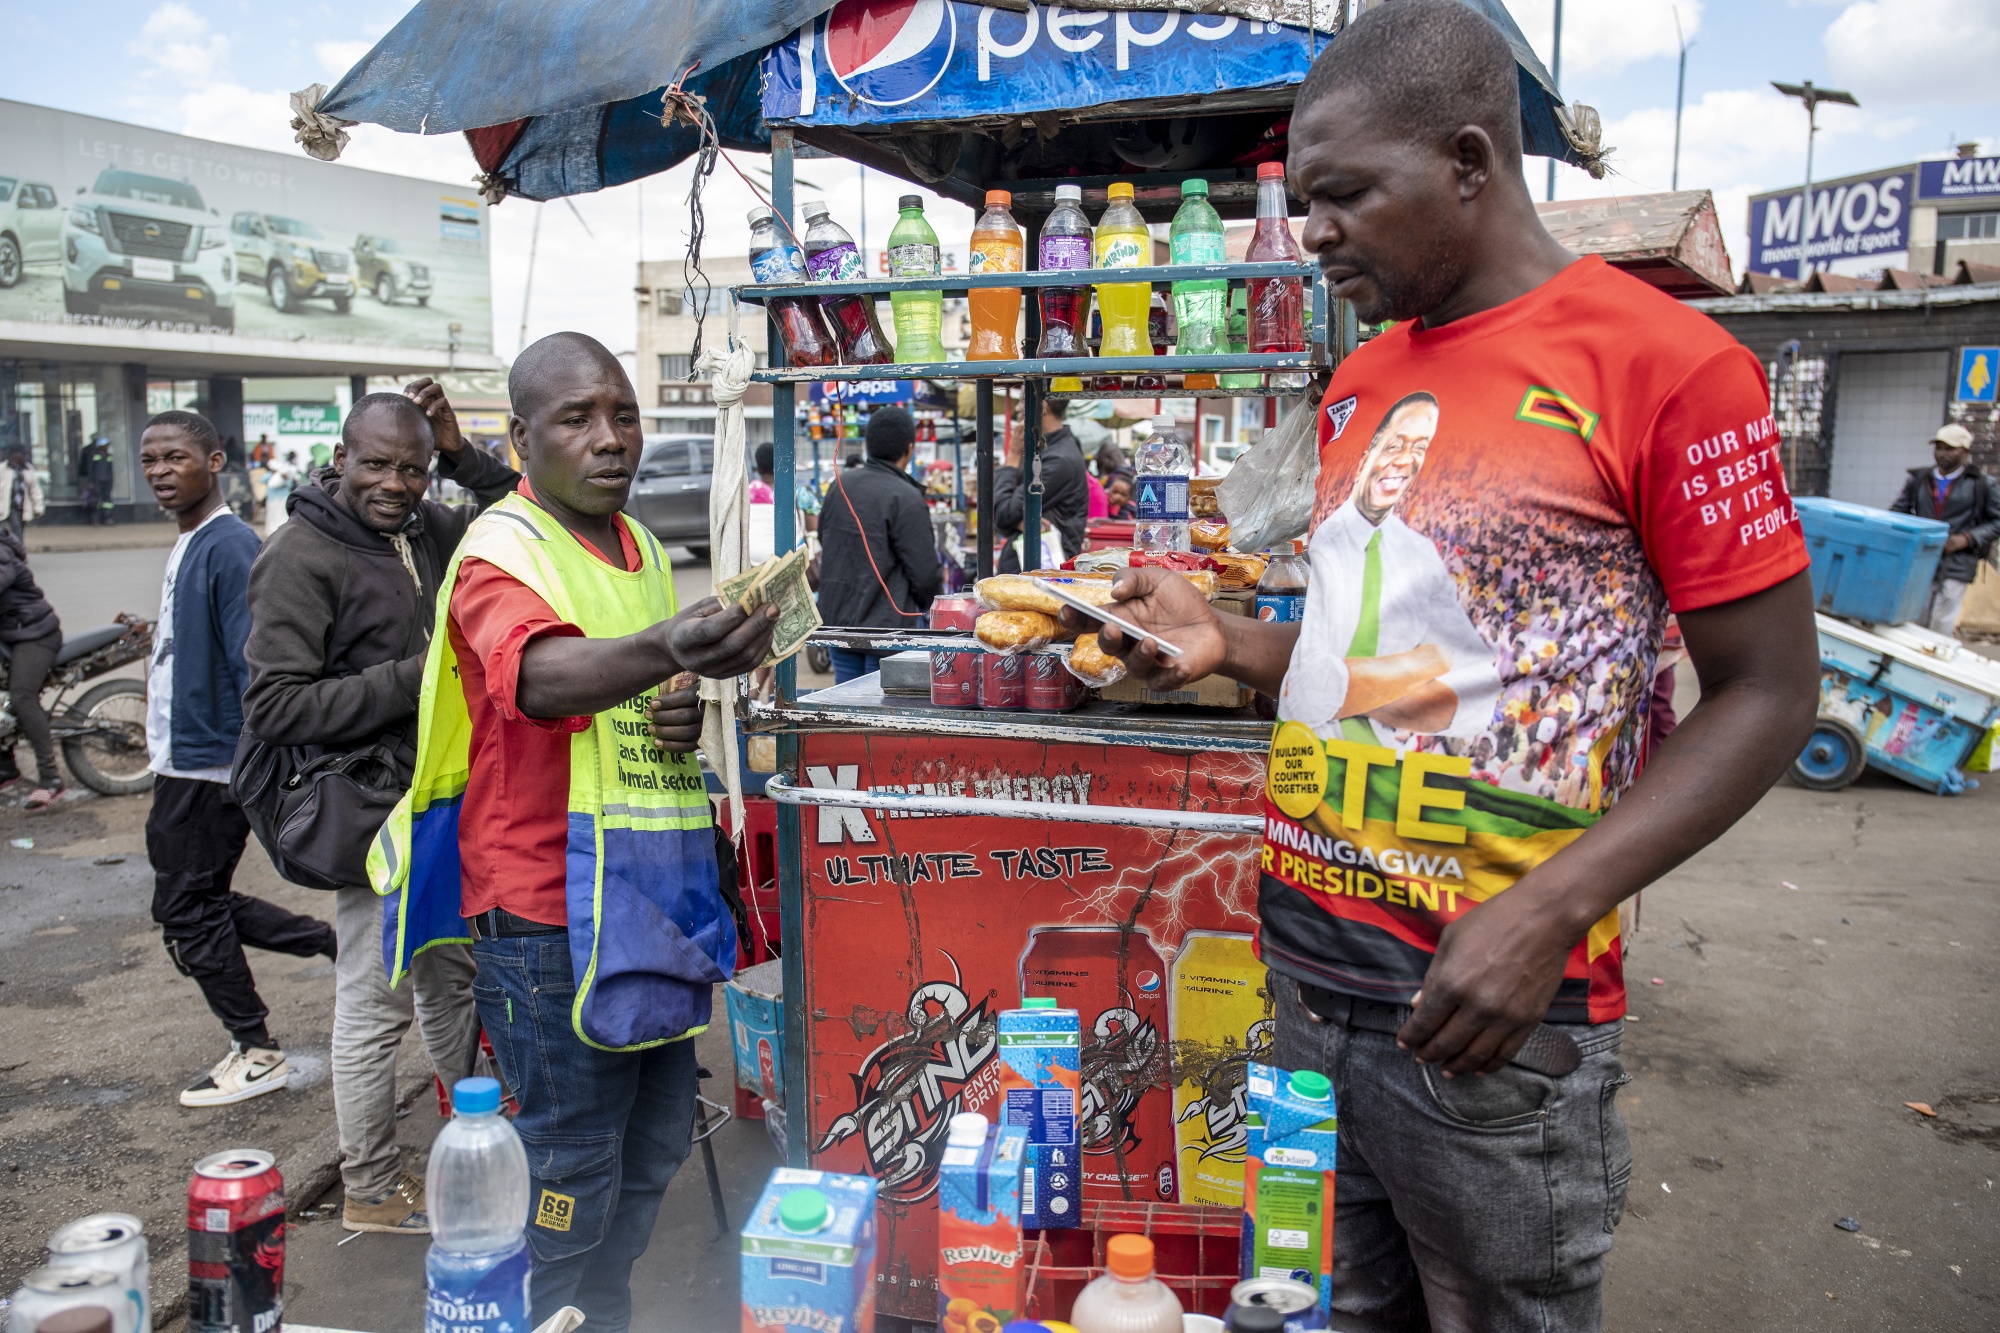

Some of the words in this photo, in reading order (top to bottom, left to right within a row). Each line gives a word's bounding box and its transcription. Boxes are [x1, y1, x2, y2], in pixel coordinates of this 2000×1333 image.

[79, 137, 145, 166] LET'S
[152, 152, 196, 174] GET
[202, 160, 228, 182] TO
[235, 168, 295, 191] WORK
[1761, 176, 1905, 247] MWOS
[1805, 233, 1842, 259] world
[1844, 231, 1858, 254] of
[1859, 226, 1902, 253] sport
[63, 312, 101, 328] BEST
[847, 380, 898, 397] pepsi
[291, 406, 325, 419] Omnia
[279, 419, 298, 432] Cash
[311, 421, 339, 434] Carry
[1686, 430, 1740, 466] OUR
[1682, 475, 1709, 501] IS
[1717, 449, 1769, 488] BEST
[1700, 497, 1732, 526] BY
[1743, 479, 1774, 512] IT'S
[1740, 502, 1799, 546] PEOPLE
[641, 742, 664, 764] for
[1275, 746, 1314, 758] BUILDING
[1285, 759, 1303, 770] OUR
[1274, 771, 1315, 782] COUNTRY
[1273, 783, 1319, 794] TOGETHER
[1267, 818, 1465, 880] MNANGAGWA
[825, 852, 982, 886] ULTIMATE
[990, 847, 1113, 881] TASTE
[1280, 850, 1465, 913] PRESIDENT
[1189, 975, 1247, 987] VITAMINS
[964, 1058, 1000, 1100] ENER
[1196, 1173, 1225, 1185] GOLD
[542, 1194, 570, 1218] 69
[540, 1212, 568, 1224] ORIGINAL
[540, 1217, 565, 1229] LEGEND
[943, 1246, 1013, 1268] Revive
[753, 1305, 845, 1332] Revive
